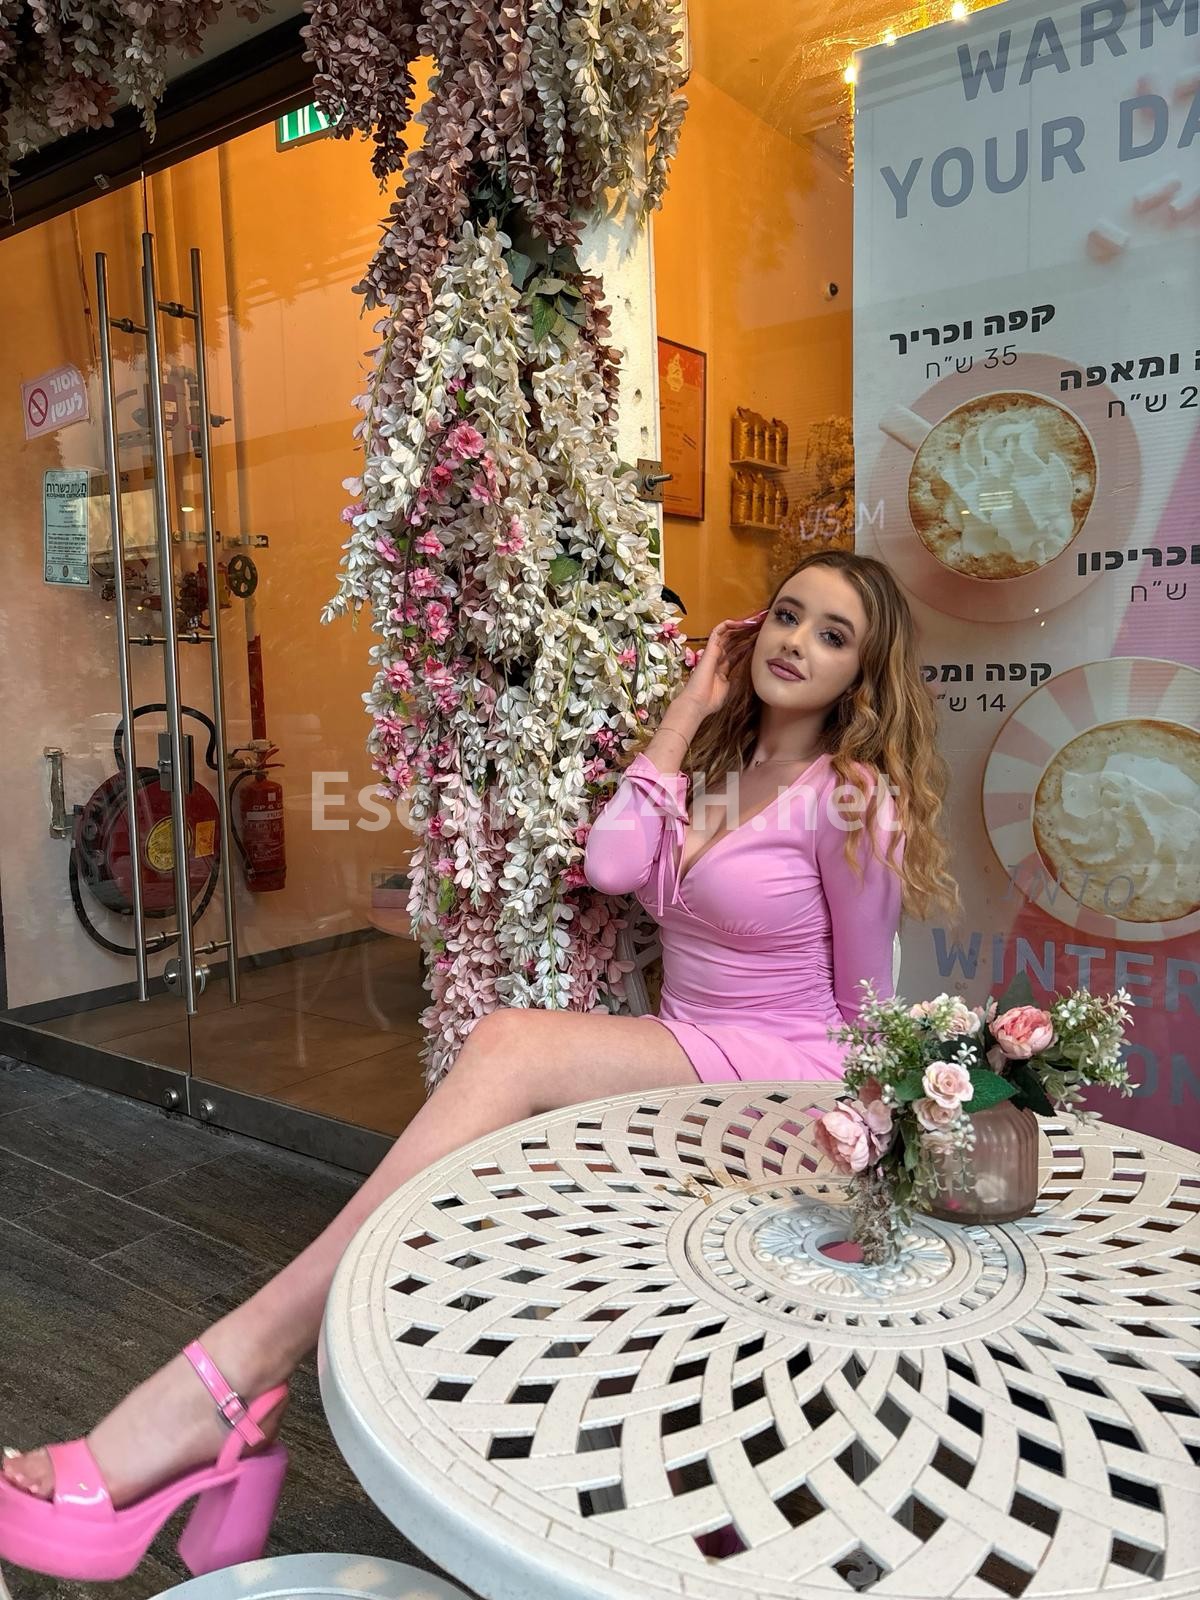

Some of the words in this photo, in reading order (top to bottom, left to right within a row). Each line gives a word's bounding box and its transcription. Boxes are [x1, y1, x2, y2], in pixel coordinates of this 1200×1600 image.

[957, 0, 1198, 101] WARM
[879, 115, 1086, 219] YOUR
[984, 304, 1056, 337] קפה
[889, 320, 973, 355] וכריך
[926, 355, 973, 379] ש"ח
[984, 344, 1018, 369] 35
[1060, 353, 1180, 391] ומאפה
[50, 370, 81, 394] אסור
[51, 392, 83, 423] לעשן
[1108, 393, 1167, 418] ש"ח
[1077, 544, 1200, 576] וכריכון
[1131, 580, 1187, 602] ש"ח
[985, 662, 1052, 687] קפה
[936, 694, 967, 712] ש"
[976, 693, 1006, 712] 14
[1000, 864, 1136, 913] INTO
[931, 927, 1200, 1018] WINTER
